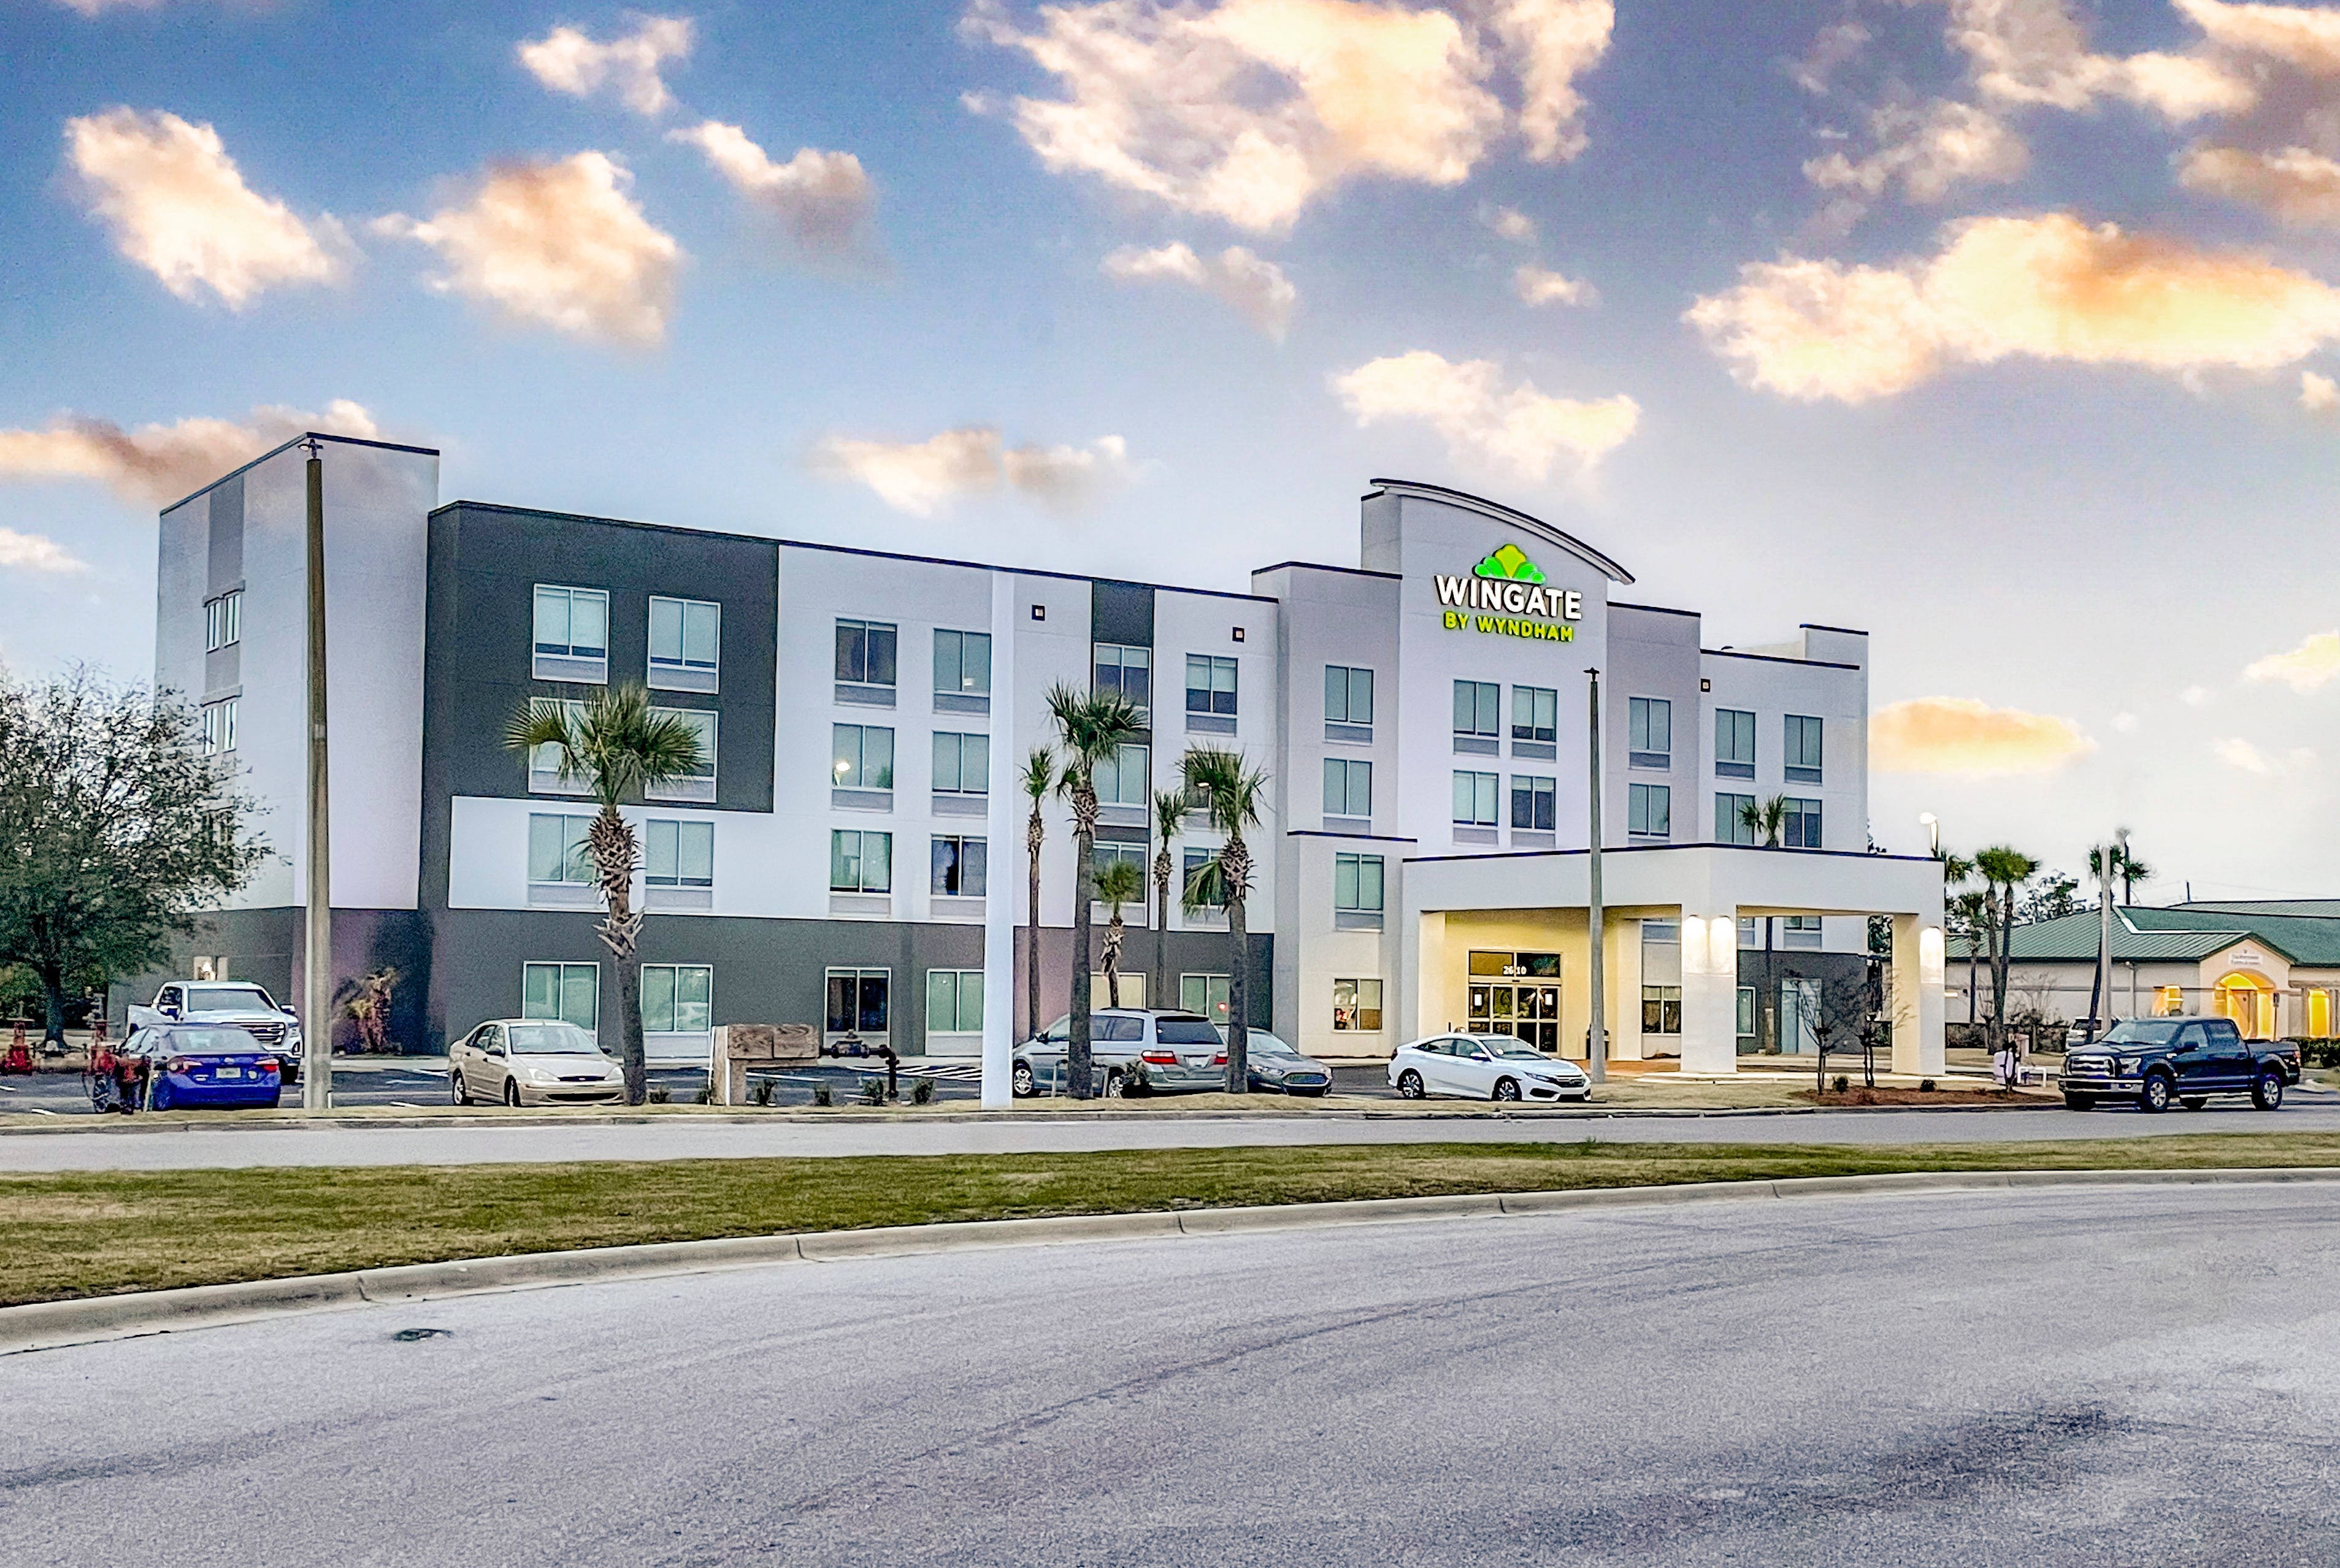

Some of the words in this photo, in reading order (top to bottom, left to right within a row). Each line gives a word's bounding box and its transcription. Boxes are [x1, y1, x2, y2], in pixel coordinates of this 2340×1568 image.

[1434, 575, 1582, 620] WINGATE
[1444, 611, 1469, 629] BY
[1476, 615, 1574, 642] WYNDHAM
[1503, 965, 1527, 975] 2610
